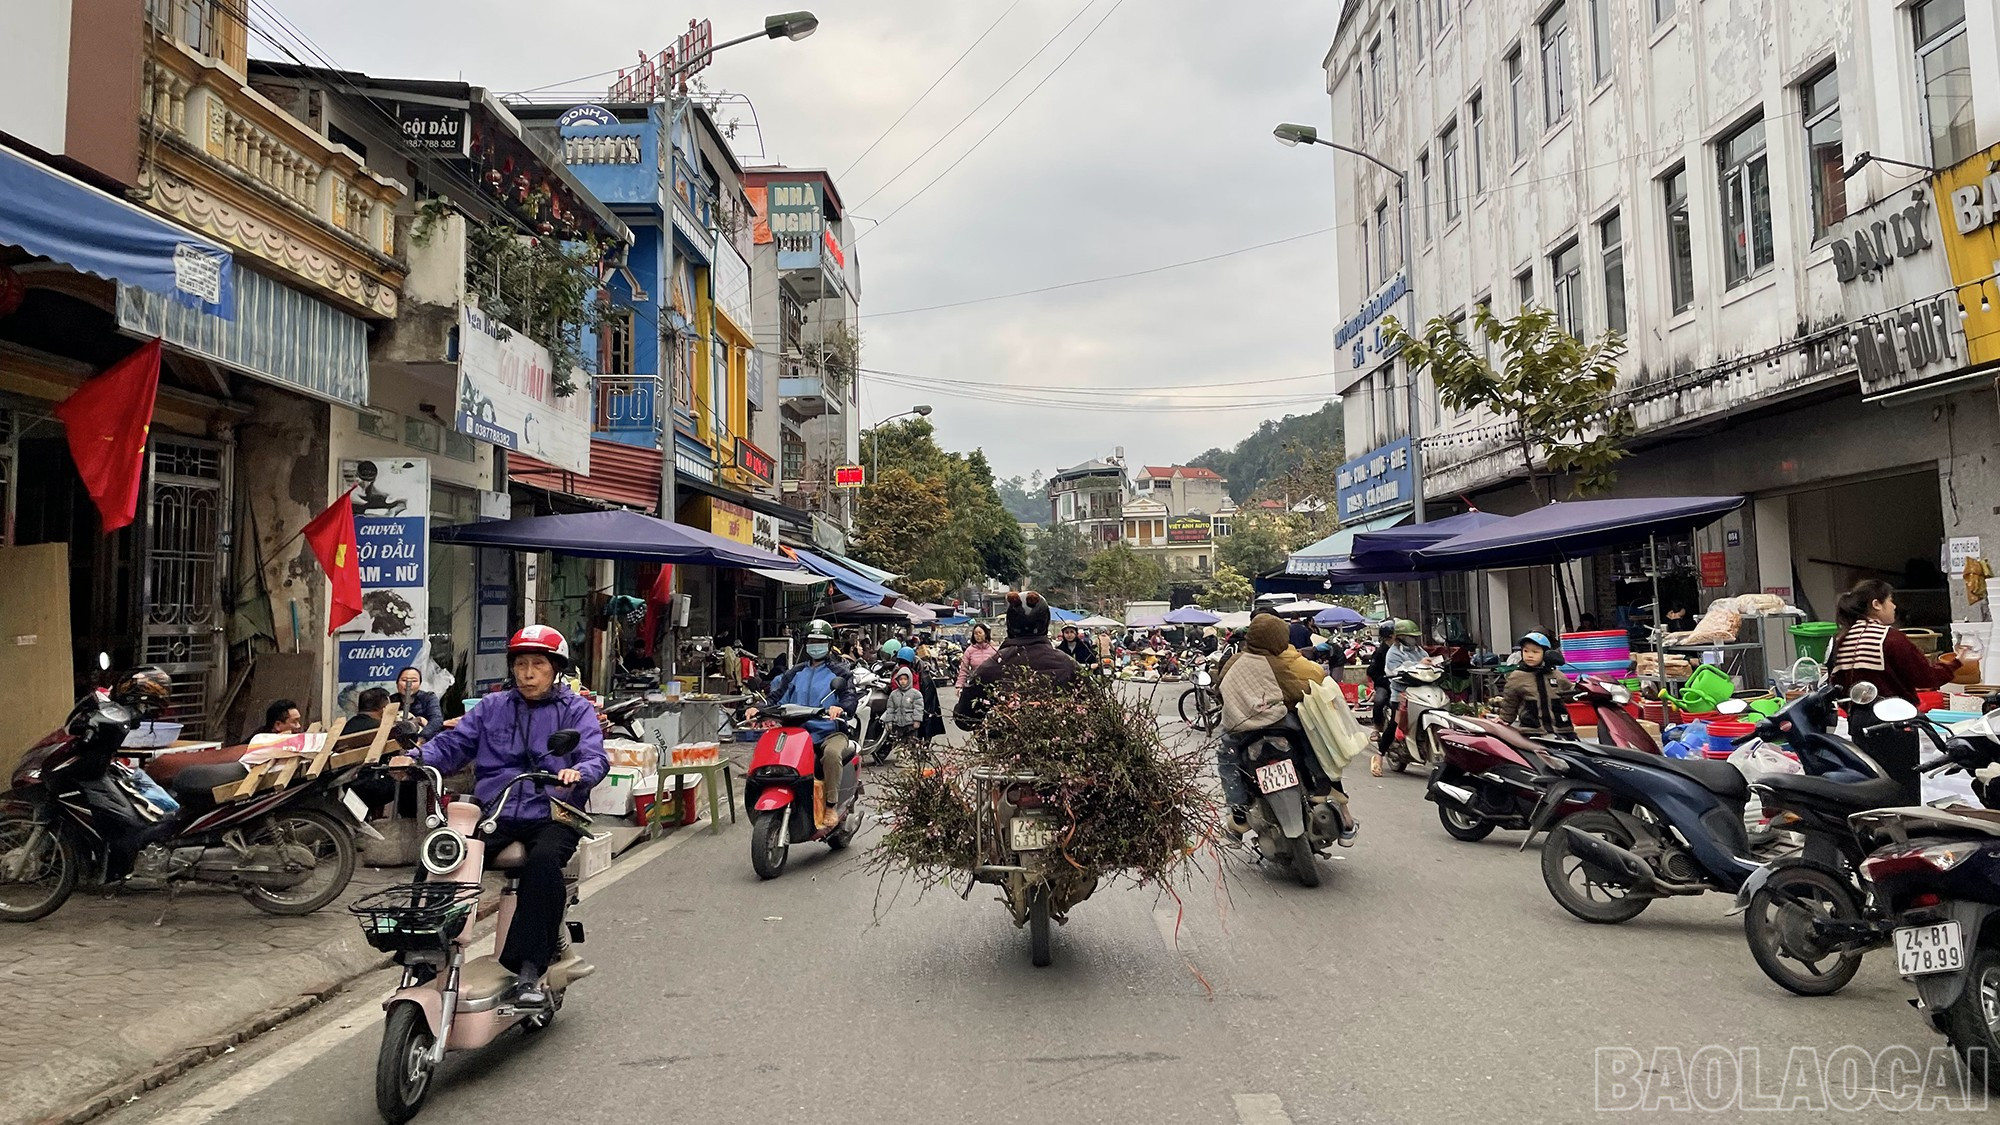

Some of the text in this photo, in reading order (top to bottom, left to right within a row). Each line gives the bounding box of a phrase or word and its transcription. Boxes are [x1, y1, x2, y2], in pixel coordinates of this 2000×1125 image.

[402, 115, 459, 139] GỘI ĐẦU
[561, 108, 609, 126] SONHA
[425, 139, 439, 148] 788
[440, 139, 456, 148] 382
[774, 183, 817, 206] NHÀ
[771, 206, 820, 232] NGHỈ
[1831, 185, 1933, 283] ĐẠI LÝ
[474, 423, 511, 447] 0387788382
[359, 522, 406, 536] CHUYÊN
[381, 538, 416, 559] ĐẦU
[395, 563, 419, 582] NỮ
[348, 643, 412, 660] CHĂM SÓC
[368, 662, 394, 677] TÓC
[1262, 763, 1288, 780] 24-B1
[1904, 925, 1949, 950] 24-B1
[1901, 946, 1959, 972] 478.99
